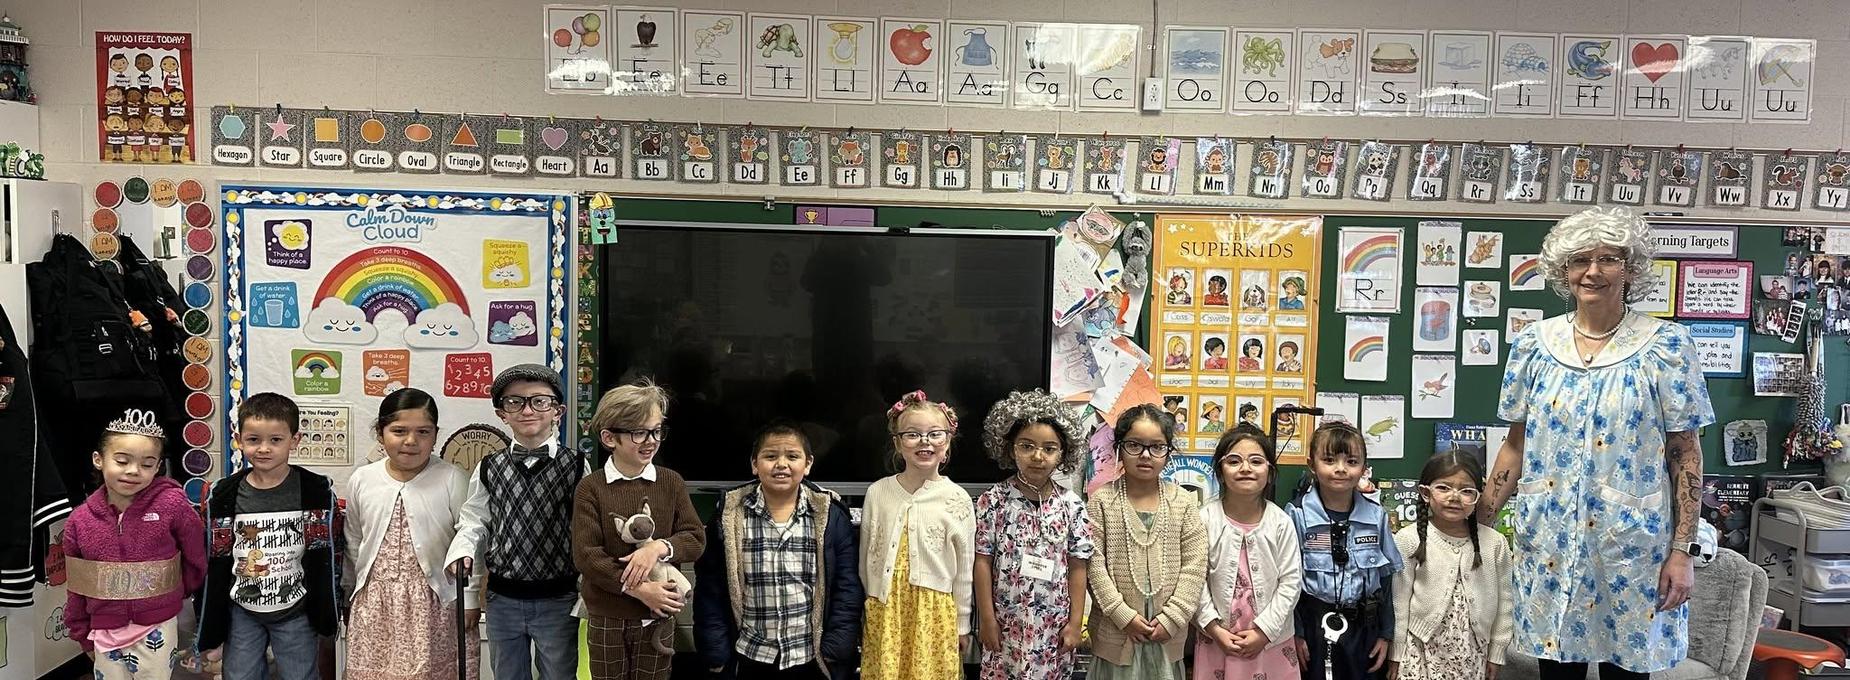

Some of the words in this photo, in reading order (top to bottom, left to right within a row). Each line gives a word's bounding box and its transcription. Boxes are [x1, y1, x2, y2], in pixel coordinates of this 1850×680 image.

[633, 59, 660, 82] Ee
[700, 62, 727, 86] Ee
[766, 66, 793, 89] Tt
[834, 69, 855, 92] Ll
[893, 70, 927, 93] Aa
[958, 73, 992, 96] Aa
[1025, 72, 1059, 104] Gg
[1092, 77, 1123, 100] Cc
[1178, 79, 1211, 101] Oo
[1245, 80, 1279, 102] Oo
[1312, 80, 1342, 103] Dd
[1379, 82, 1407, 104] Ss
[1517, 84, 1530, 106] Ii
[1577, 85, 1602, 107] Ff
[1635, 86, 1670, 109] Hh
[1702, 89, 1732, 111] Uu
[1766, 90, 1796, 112] Uu
[218, 150, 248, 161] Hexagon
[271, 150, 291, 161] Star
[314, 151, 342, 163] Square
[359, 154, 385, 165] Circle
[408, 156, 427, 167] Oval
[449, 156, 480, 168] Triangle
[493, 159, 527, 170] Rectangle
[542, 160, 567, 171] Heart
[593, 159, 608, 174] Aa
[645, 163, 660, 176] Bb
[692, 166, 705, 178] Cc
[741, 166, 756, 179] Dd
[794, 168, 808, 181] Ee
[844, 170, 857, 183] Ff
[894, 168, 908, 184] Gg
[943, 172, 957, 186] Hh
[1002, 173, 1009, 187] Ii
[1048, 173, 1058, 189] Jj
[1098, 176, 1110, 189] Kk
[1151, 176, 1161, 190] Ll
[1204, 177, 1224, 190] Mm
[1316, 181, 1330, 193] Oo
[1366, 178, 1378, 194] Pp
[1262, 182, 1276, 194] Nn
[1421, 181, 1436, 198] Qq
[1471, 184, 1484, 198] Rr
[1520, 184, 1534, 198] Ss
[1573, 186, 1585, 199] Tt
[1619, 186, 1633, 201] Uu
[1668, 188, 1682, 202] Vv
[1720, 188, 1740, 202] Ww
[1775, 192, 1790, 206] Xx
[1827, 190, 1841, 208] Yy
[347, 209, 389, 227] Calm
[391, 209, 434, 226] Down
[364, 225, 418, 240] Cloud
[1690, 235, 1729, 249] Targets
[1180, 241, 1293, 259] SUPERKIDS
[360, 258, 374, 267] Take
[1696, 267, 1724, 275] Language
[367, 276, 383, 284] Color
[362, 290, 372, 299] Get
[1355, 279, 1384, 301] Rr
[362, 298, 376, 308] Think
[448, 364, 453, 374] 1
[455, 370, 462, 380] 2
[465, 364, 472, 374] 3
[474, 369, 480, 379] 4
[484, 366, 490, 376] 5
[446, 380, 452, 390] 6
[453, 385, 460, 395] 7
[463, 383, 470, 393] 8
[470, 380, 478, 391] 9
[480, 383, 491, 394] 10
[124, 408, 155, 427] 100
[462, 431, 492, 440] WORRY
[1451, 430, 1485, 440] WHA
[1394, 492, 1419, 500] GUESS
[1396, 504, 1417, 520] 10
[268, 557, 285, 565] 100
[271, 564, 293, 573] School
